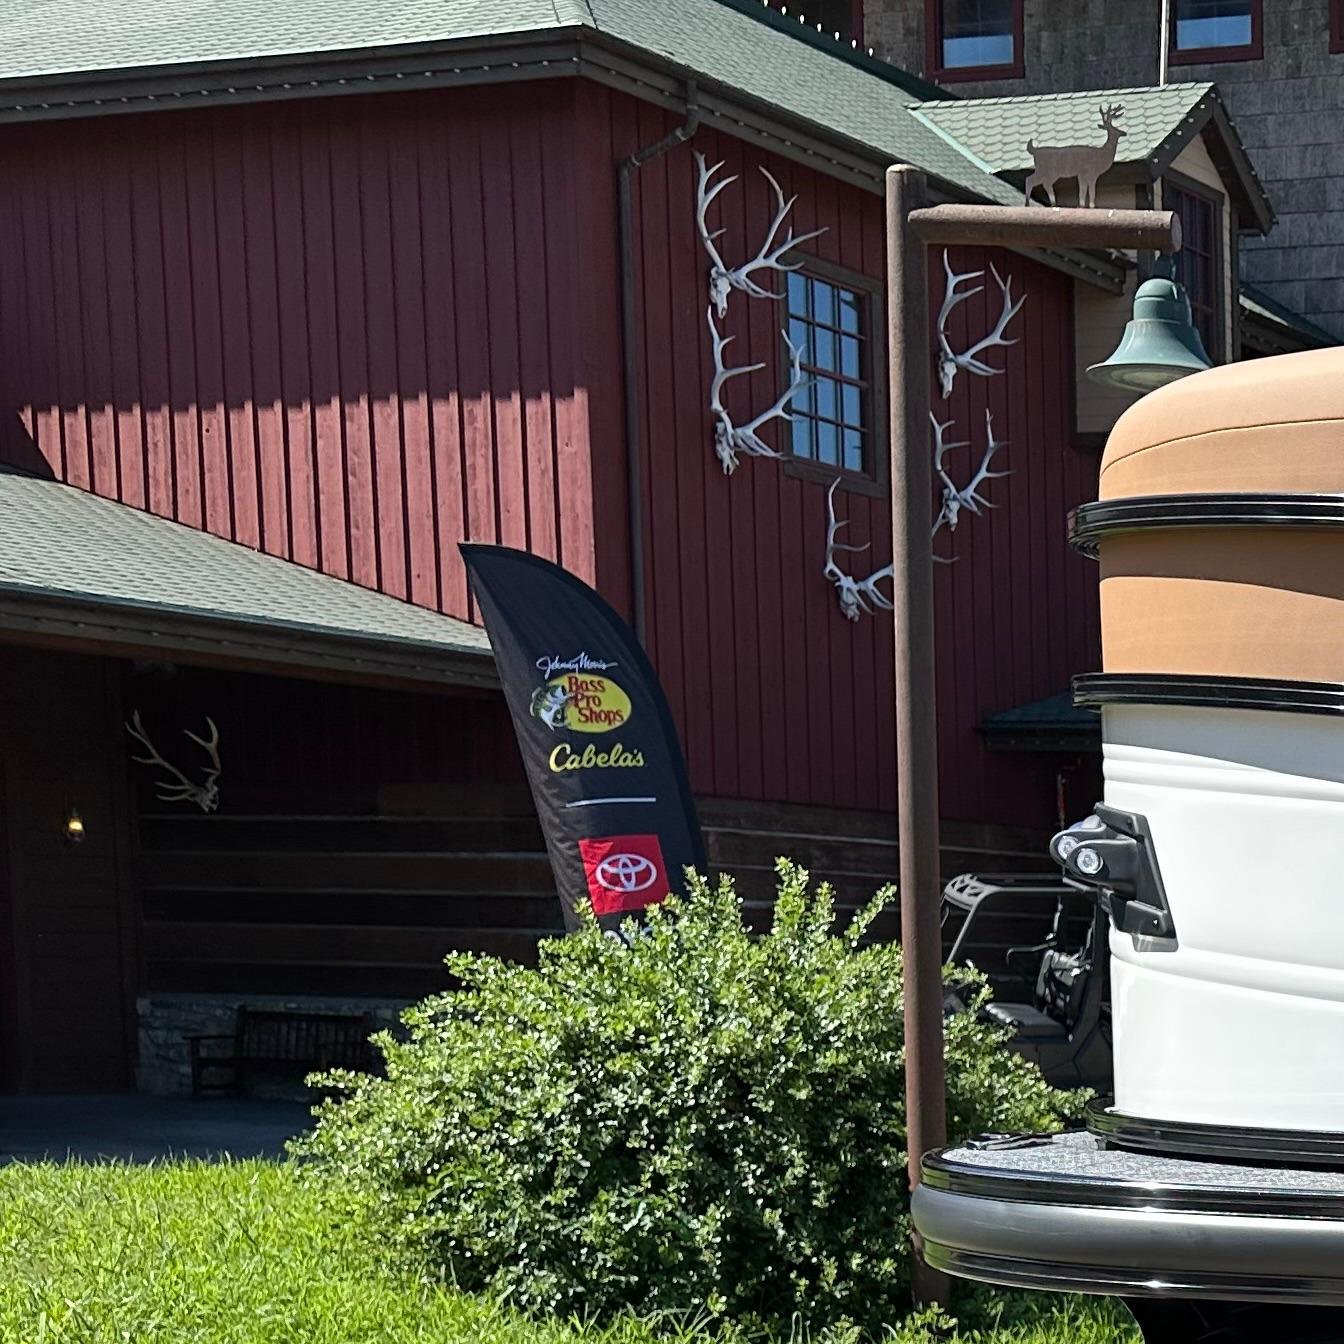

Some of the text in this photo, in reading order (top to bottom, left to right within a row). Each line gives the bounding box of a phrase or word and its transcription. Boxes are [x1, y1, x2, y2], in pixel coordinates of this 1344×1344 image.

[567, 675, 606, 693] Bass
[573, 692, 602, 709] Pro
[578, 707, 624, 726] Shops
[549, 742, 645, 773] Cabela's
